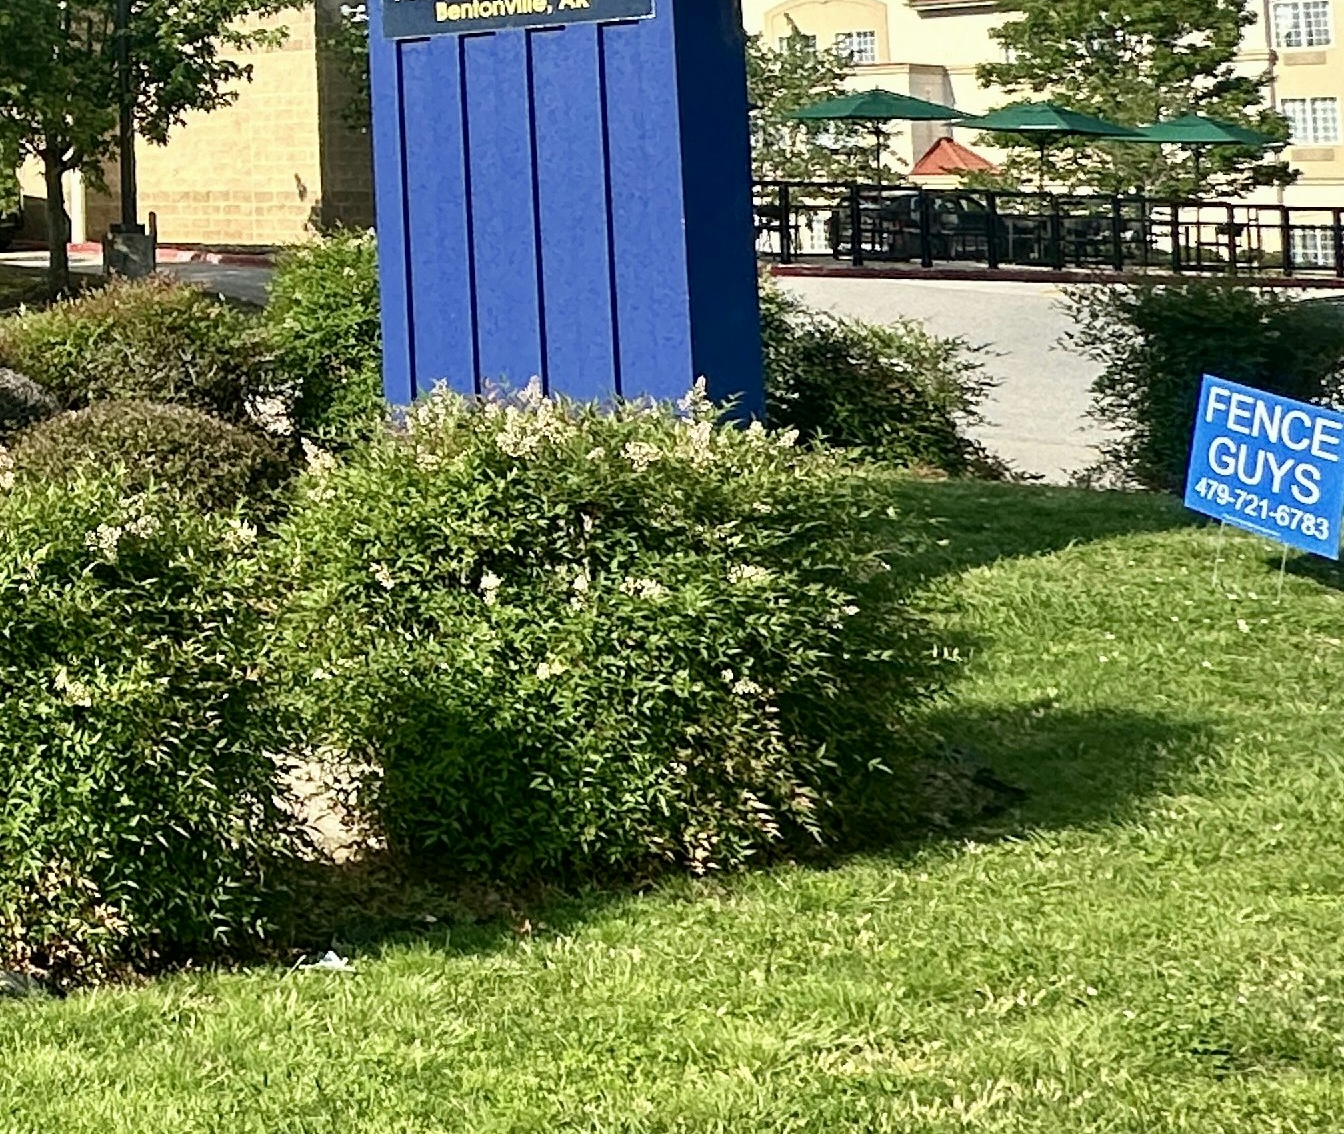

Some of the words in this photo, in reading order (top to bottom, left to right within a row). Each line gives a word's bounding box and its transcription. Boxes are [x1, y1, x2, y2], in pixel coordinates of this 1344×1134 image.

[1205, 386, 1344, 462] FENCE
[1208, 436, 1322, 505] GUYS
[1194, 477, 1330, 541] 479-721-6783
